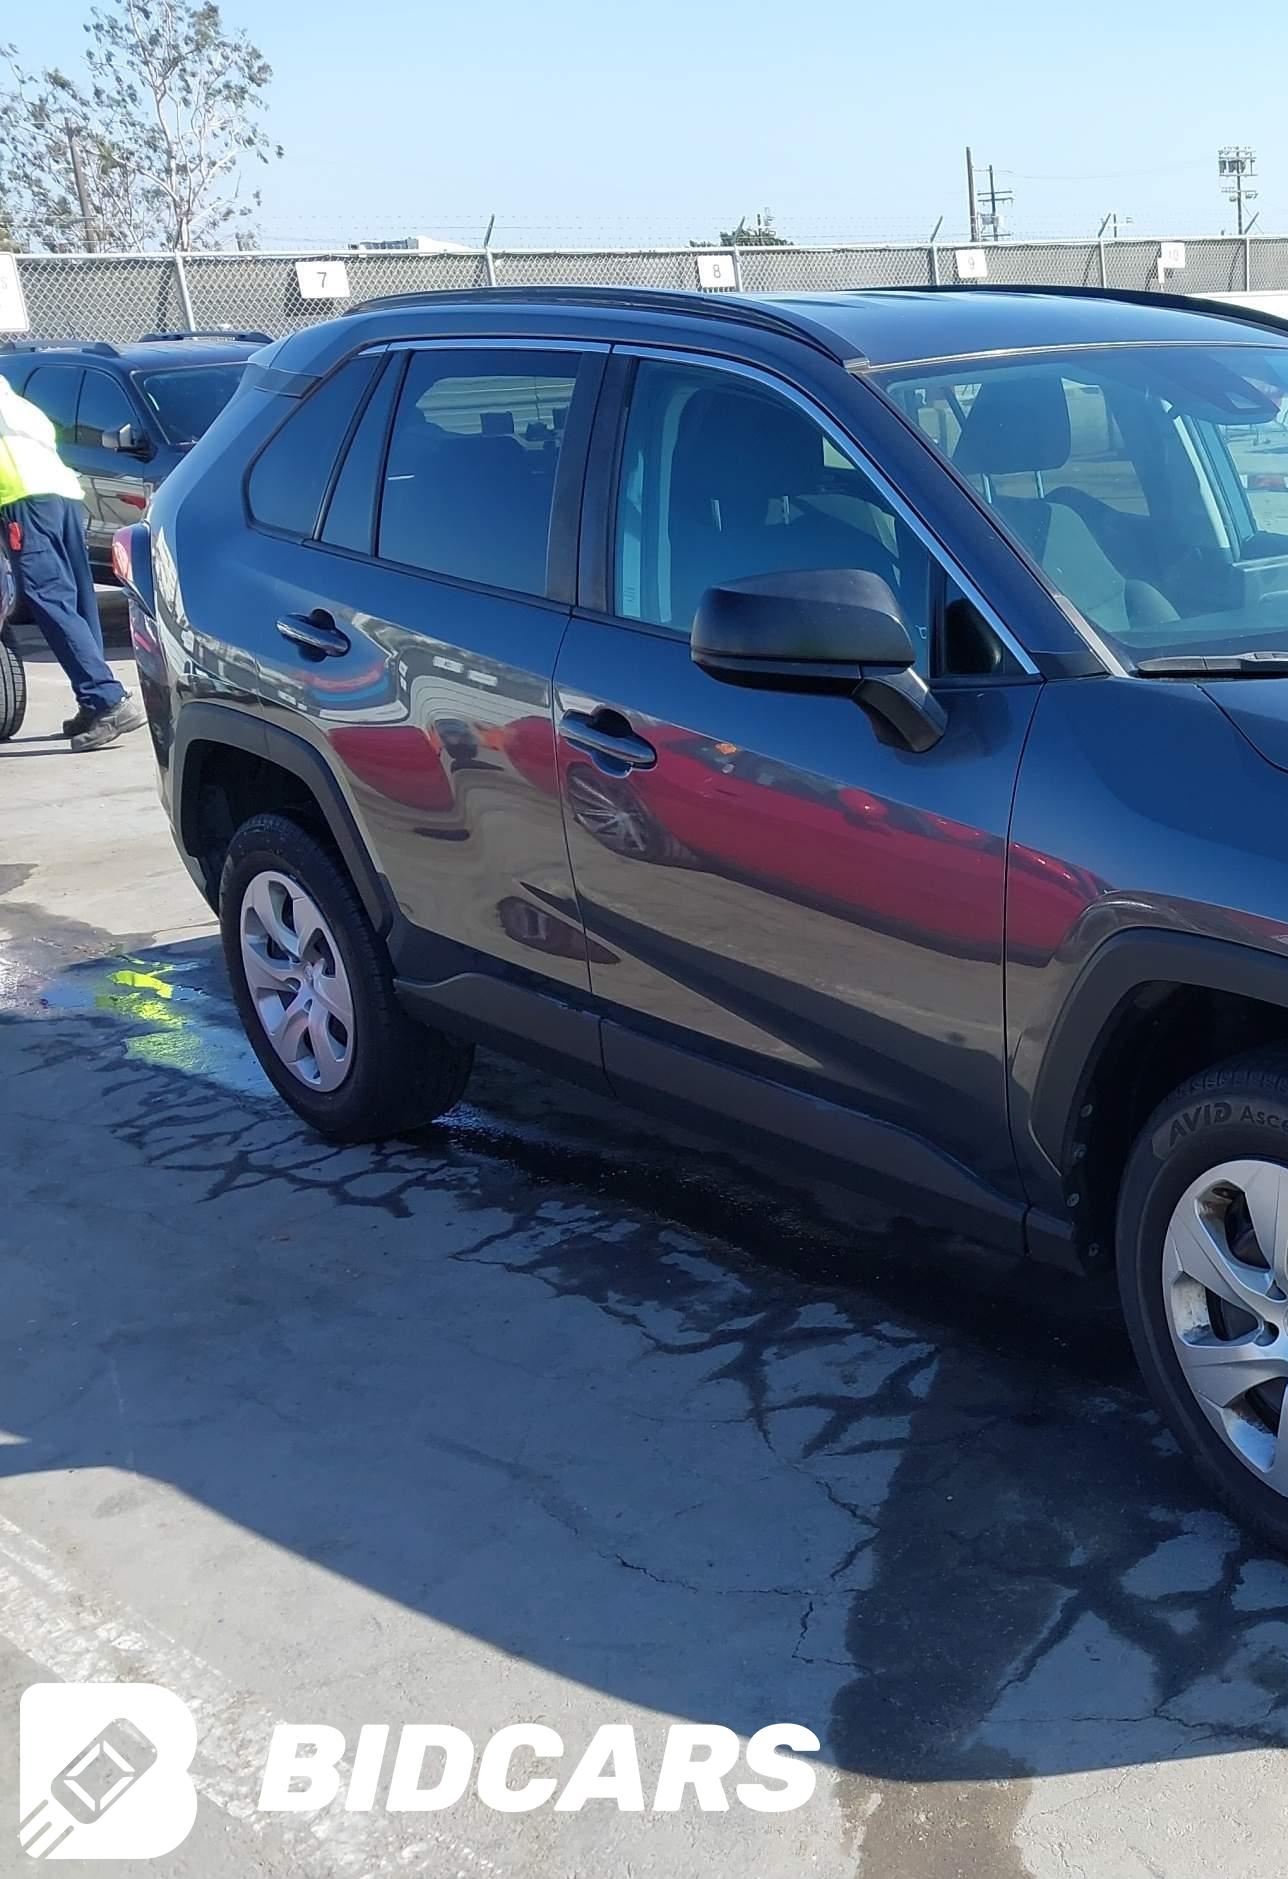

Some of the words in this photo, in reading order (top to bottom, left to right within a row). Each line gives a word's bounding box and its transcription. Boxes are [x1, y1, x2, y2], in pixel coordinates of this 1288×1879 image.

[712, 263, 722, 279] 8
[967, 256, 976, 270] 9
[316, 271, 328, 289] 7
[1169, 1101, 1232, 1148] AVID
